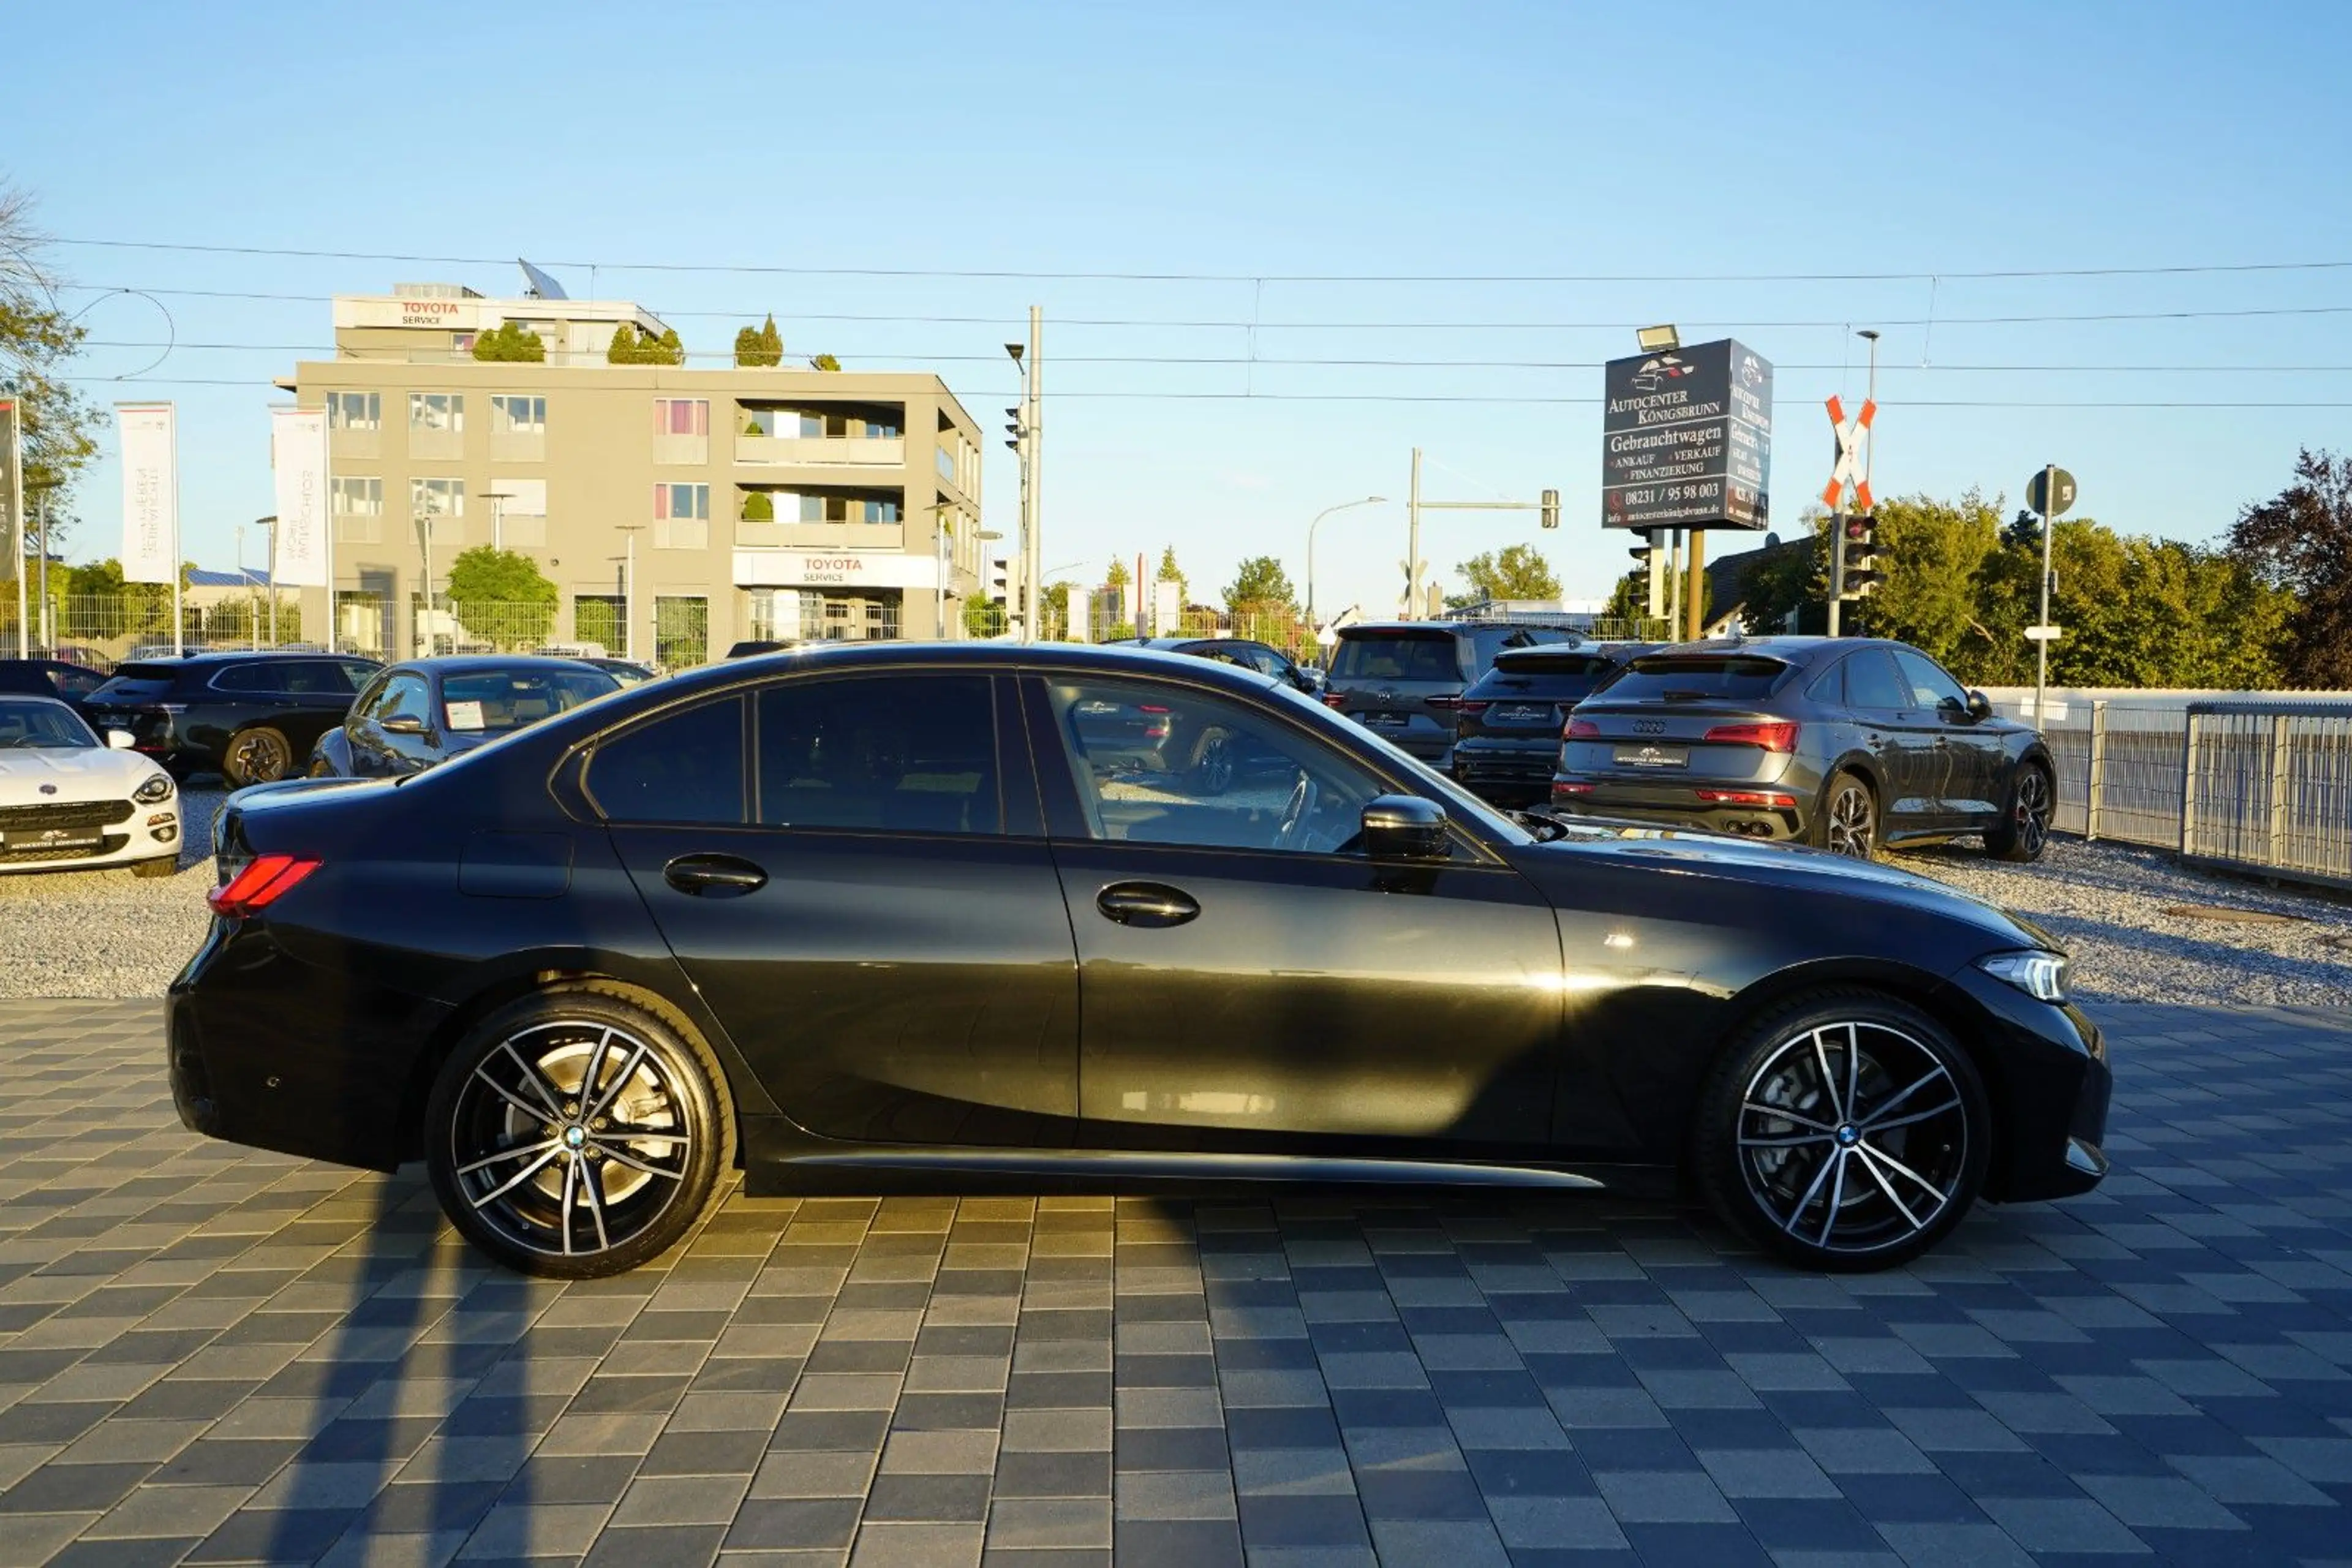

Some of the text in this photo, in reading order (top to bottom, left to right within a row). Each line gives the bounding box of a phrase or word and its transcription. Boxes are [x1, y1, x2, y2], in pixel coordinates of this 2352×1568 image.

[402, 302, 459, 314] TOYOTA
[402, 315, 440, 324] SERVICE
[1608, 390, 1688, 413] AUTOCENTER
[1611, 427, 1721, 453] Gebrauchtwagen
[1615, 454, 1656, 468] ANKAUF
[1673, 446, 1722, 461] VERKAUF
[1629, 462, 1705, 480] FINANZIERUNG
[1625, 491, 1654, 505] 08231
[1668, 488, 1681, 501] 95
[1684, 486, 1697, 499] 98
[1699, 483, 1719, 497] 003
[804, 558, 863, 570] TOYOTA
